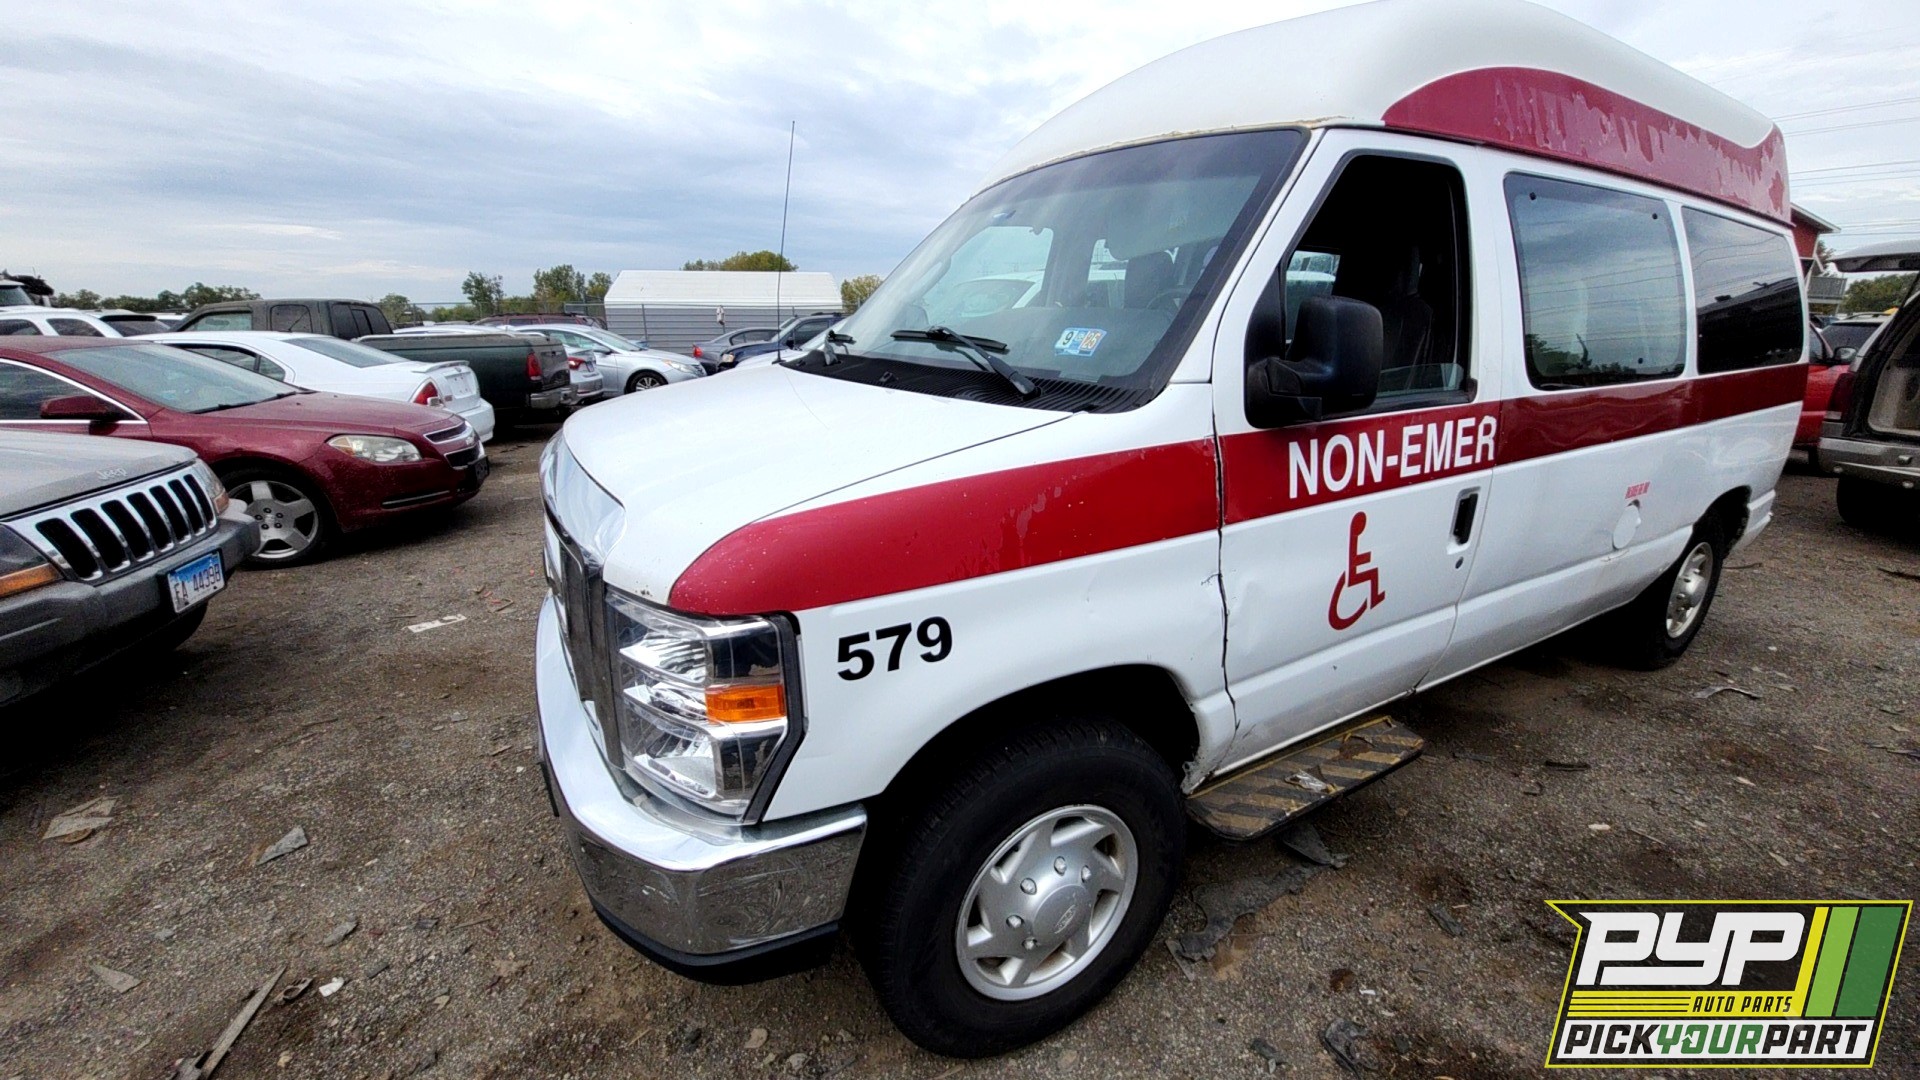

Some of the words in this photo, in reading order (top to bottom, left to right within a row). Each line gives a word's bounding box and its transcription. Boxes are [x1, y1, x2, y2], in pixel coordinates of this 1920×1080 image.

[1062, 331, 1074, 345] 9
[96, 467, 128, 480] Jeep
[1288, 415, 1497, 500] NON-EMER
[837, 616, 953, 681] 579
